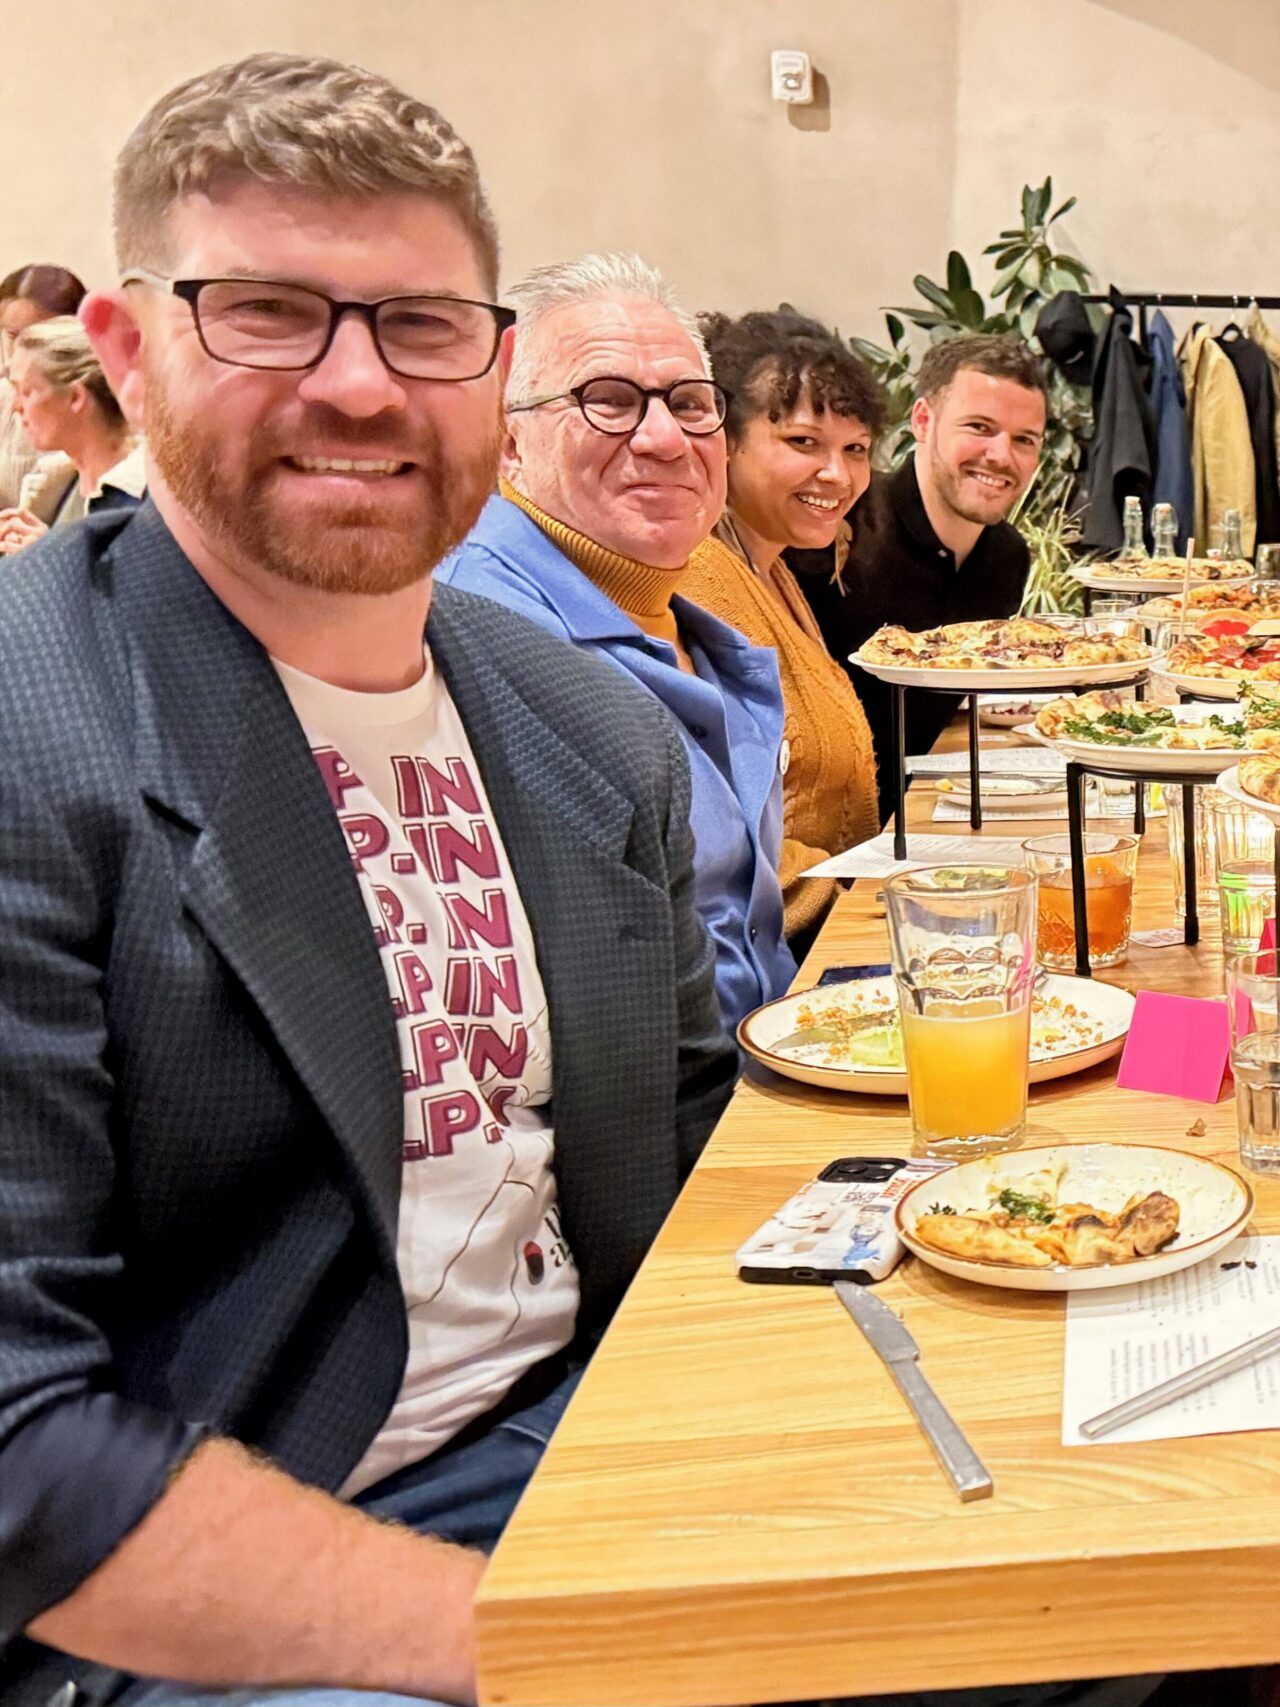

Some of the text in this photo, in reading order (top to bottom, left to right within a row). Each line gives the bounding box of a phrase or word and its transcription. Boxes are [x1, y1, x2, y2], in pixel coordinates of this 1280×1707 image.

[391, 756, 484, 818] IN
[402, 819, 501, 884] IN
[445, 955, 523, 1017] IN
